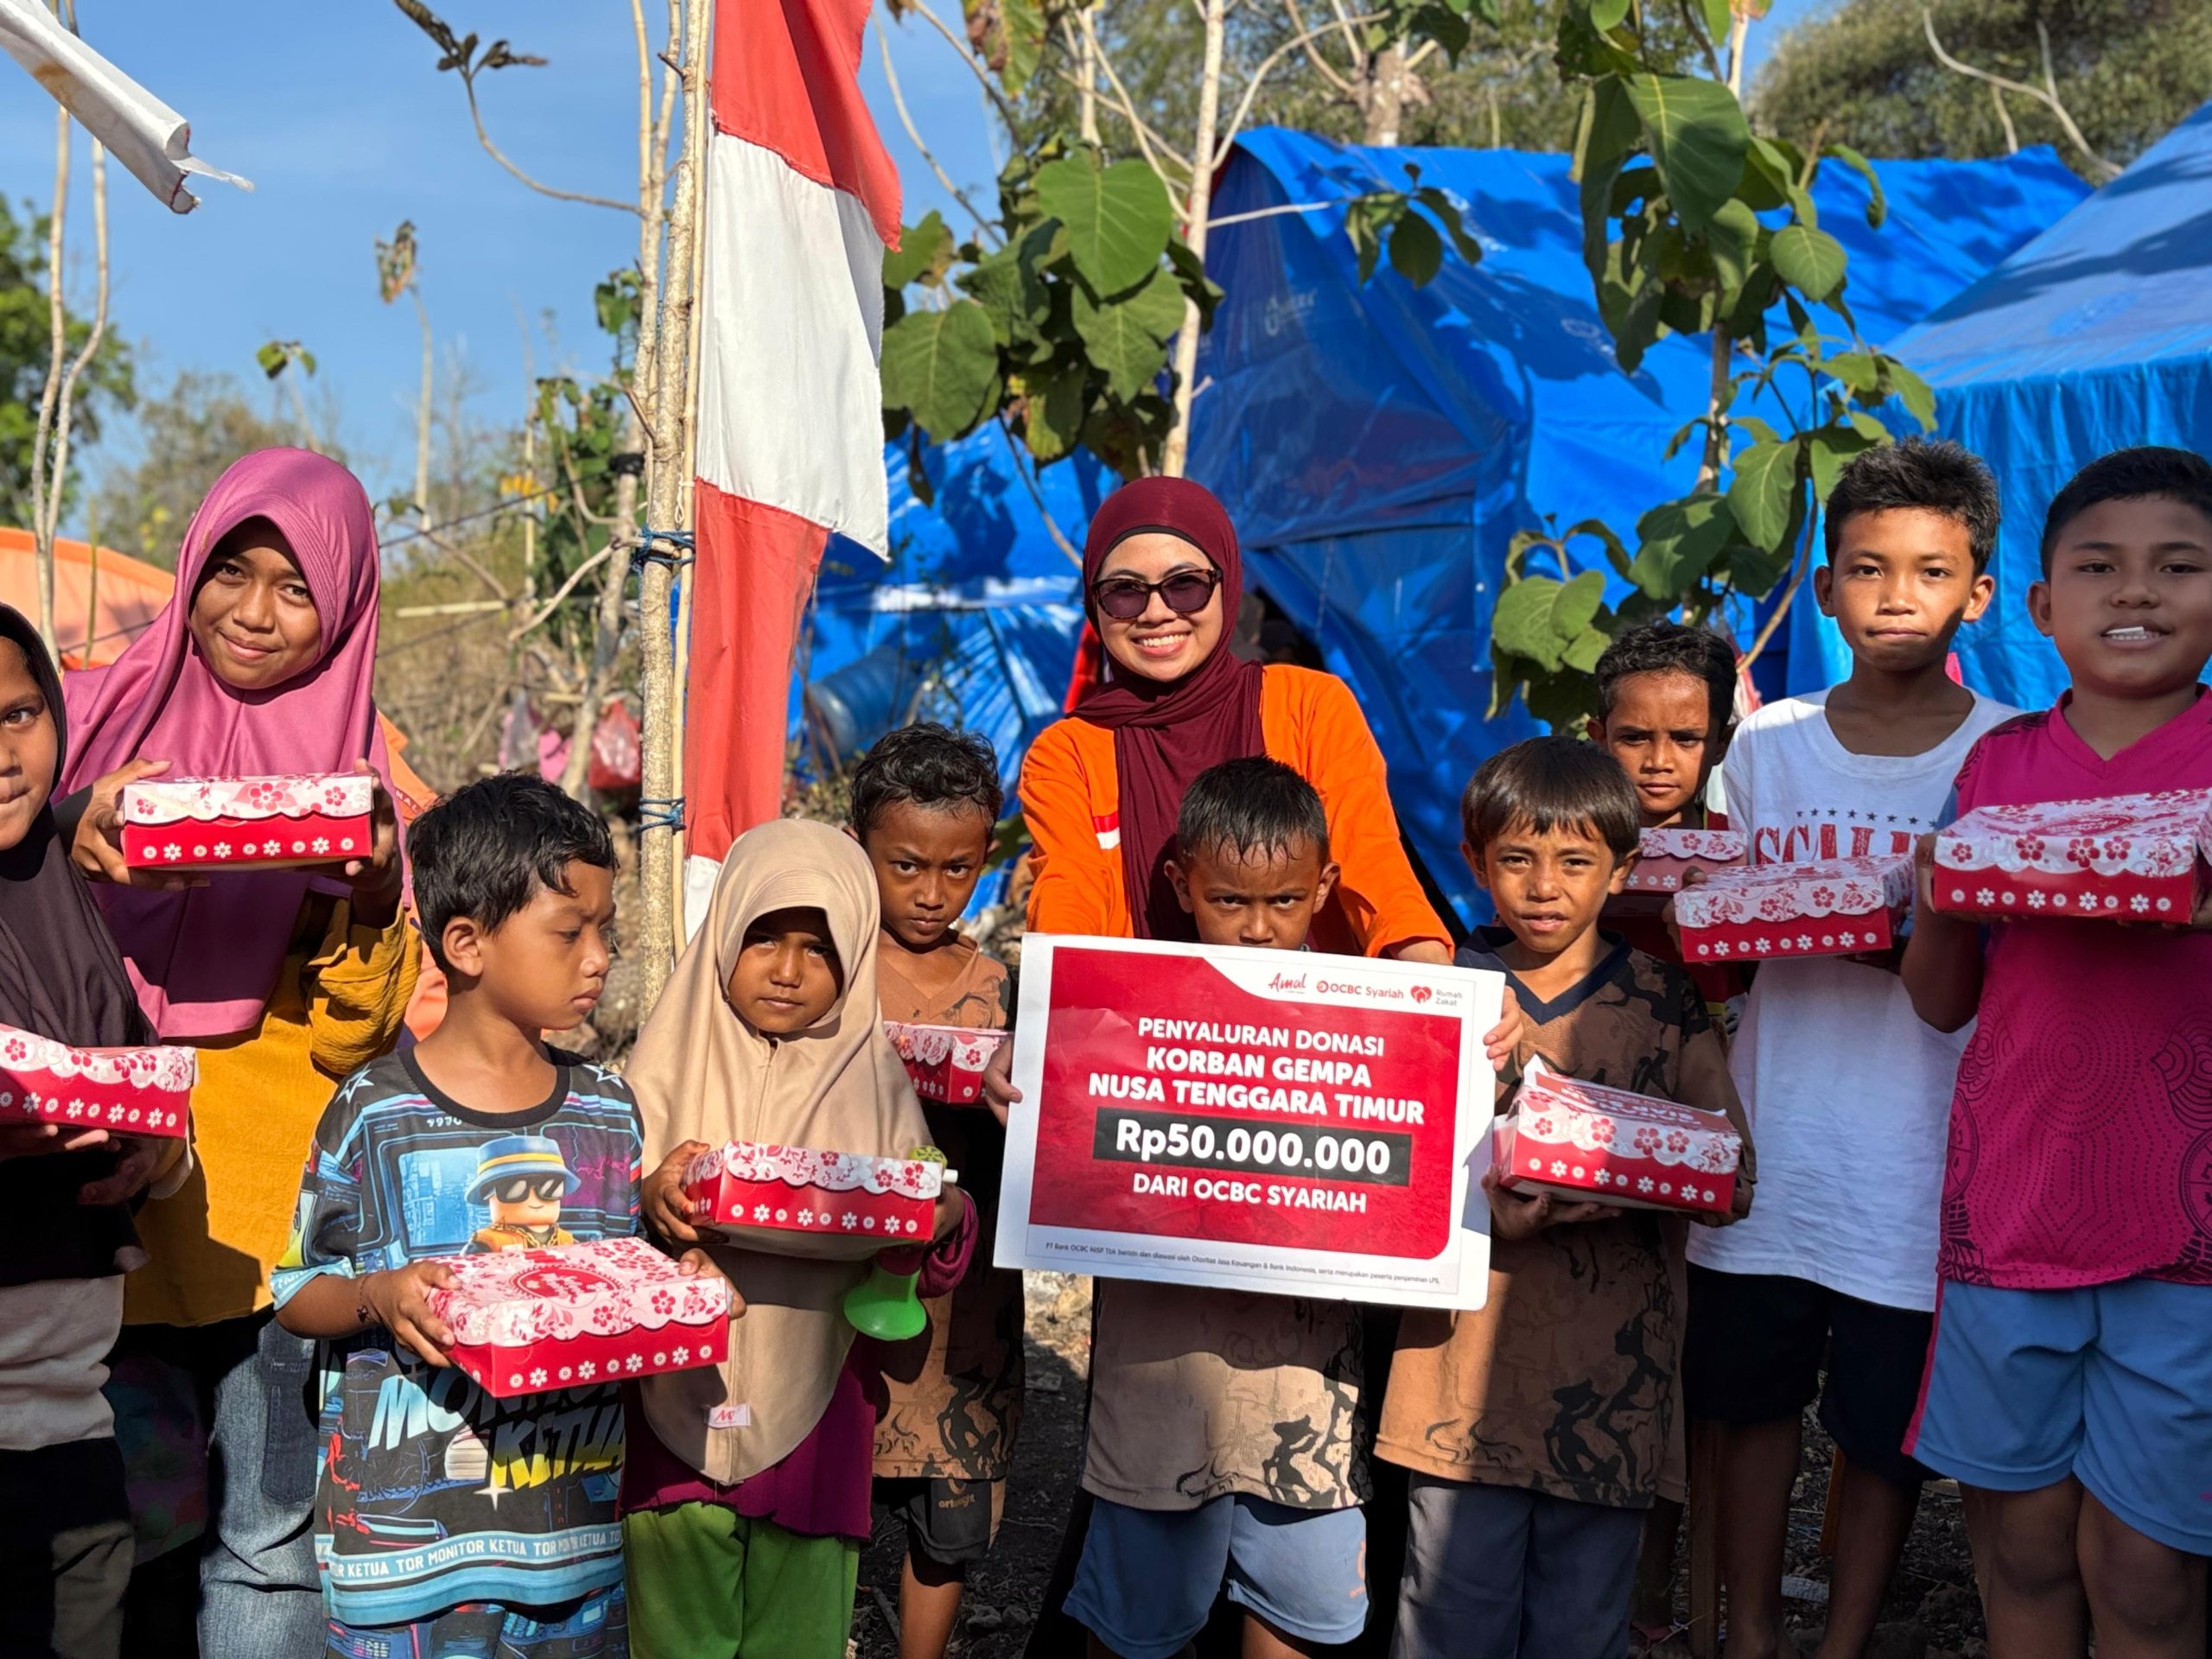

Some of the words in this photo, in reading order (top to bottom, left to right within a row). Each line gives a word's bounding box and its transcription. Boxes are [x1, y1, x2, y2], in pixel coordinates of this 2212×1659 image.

[1268, 972, 1306, 992] Amal
[1331, 983, 1362, 995] OCBC
[1365, 986, 1404, 999] Syariah
[1138, 1017, 1289, 1048] PENYALURAN
[1295, 1029, 1384, 1057] DONASI
[1146, 1046, 1265, 1078] KORBAN
[1272, 1056, 1372, 1088] GEMPA
[1089, 1072, 1165, 1103] NUSA
[1172, 1079, 1328, 1116] TENGGARA
[1334, 1093, 1425, 1125] TIMUR
[1116, 1118, 1390, 1174] Rp50.000.000
[1133, 1173, 1188, 1198] DARI
[1193, 1178, 1262, 1204] OCBC
[1267, 1185, 1367, 1213] SYARIAH
[347, 1561, 390, 1577] KETUA
[396, 1557, 424, 1573] TOR
[428, 1539, 485, 1566] MONITOR
[489, 1539, 527, 1555] KETUA
[533, 1541, 556, 1555] TOR
